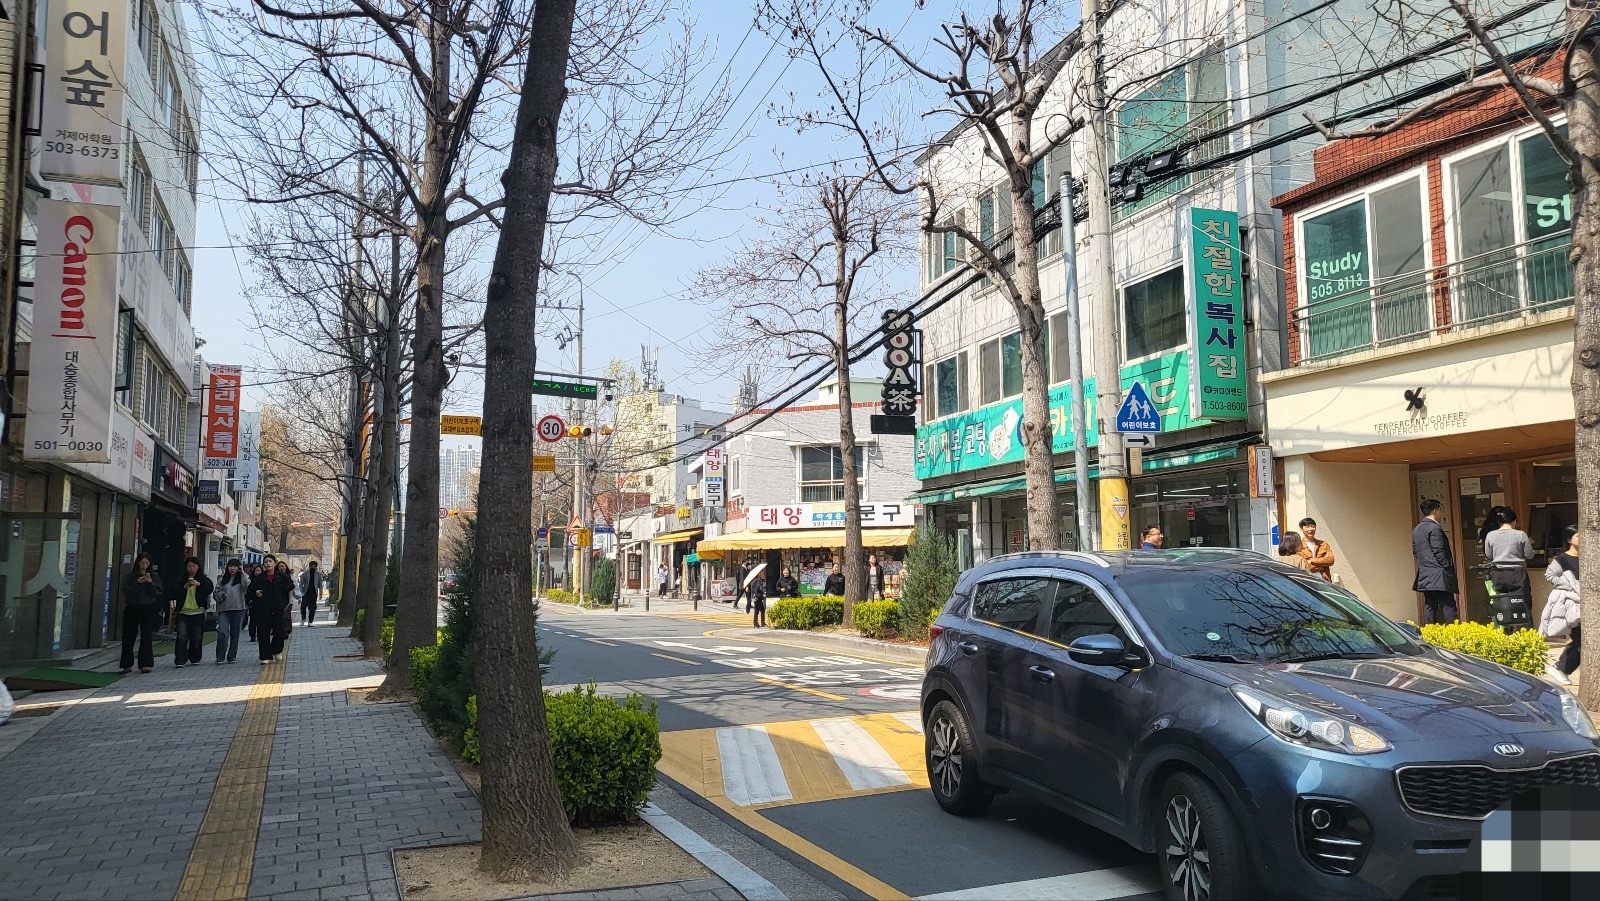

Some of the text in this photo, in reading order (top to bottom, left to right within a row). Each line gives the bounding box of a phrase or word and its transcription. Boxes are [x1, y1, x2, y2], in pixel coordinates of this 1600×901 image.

[55, 130, 111, 144] 거제어학원
[45, 141, 119, 160] 503-6373
[60, 215, 94, 331] Canon
[1310, 251, 1362, 279] Study
[1311, 272, 1363, 300] 505.8113
[1201, 218, 1239, 380] 친절한 복사집
[1203, 401, 1246, 411] T.503-8600
[213, 405, 236, 428] 복사
[1121, 421, 1157, 429] 어린이보호
[1374, 419, 1427, 432] TENPERCENT
[543, 422, 559, 436] 30
[34, 440, 103, 452] 501-0030
[212, 431, 234, 454] 출력
[207, 458, 236, 467] 503-3481
[707, 483, 721, 505] 문구
[760, 507, 803, 526] 태양
[859, 504, 901, 522] 문구
[1499, 744, 1521, 754] KIA
